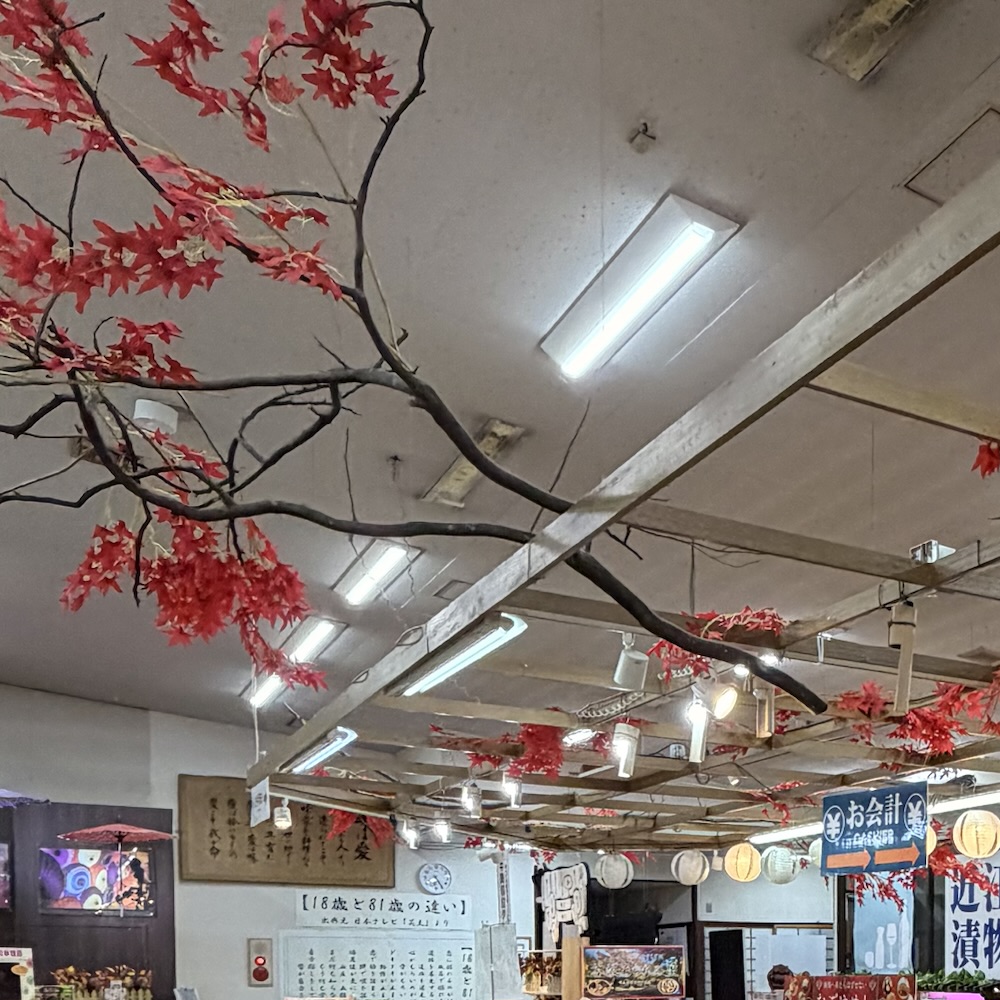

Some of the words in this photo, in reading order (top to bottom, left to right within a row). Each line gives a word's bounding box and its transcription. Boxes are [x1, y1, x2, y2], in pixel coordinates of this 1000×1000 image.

[846, 793, 902, 829] お会計
[302, 894, 466, 915] 【18歳と81歳の違い】
